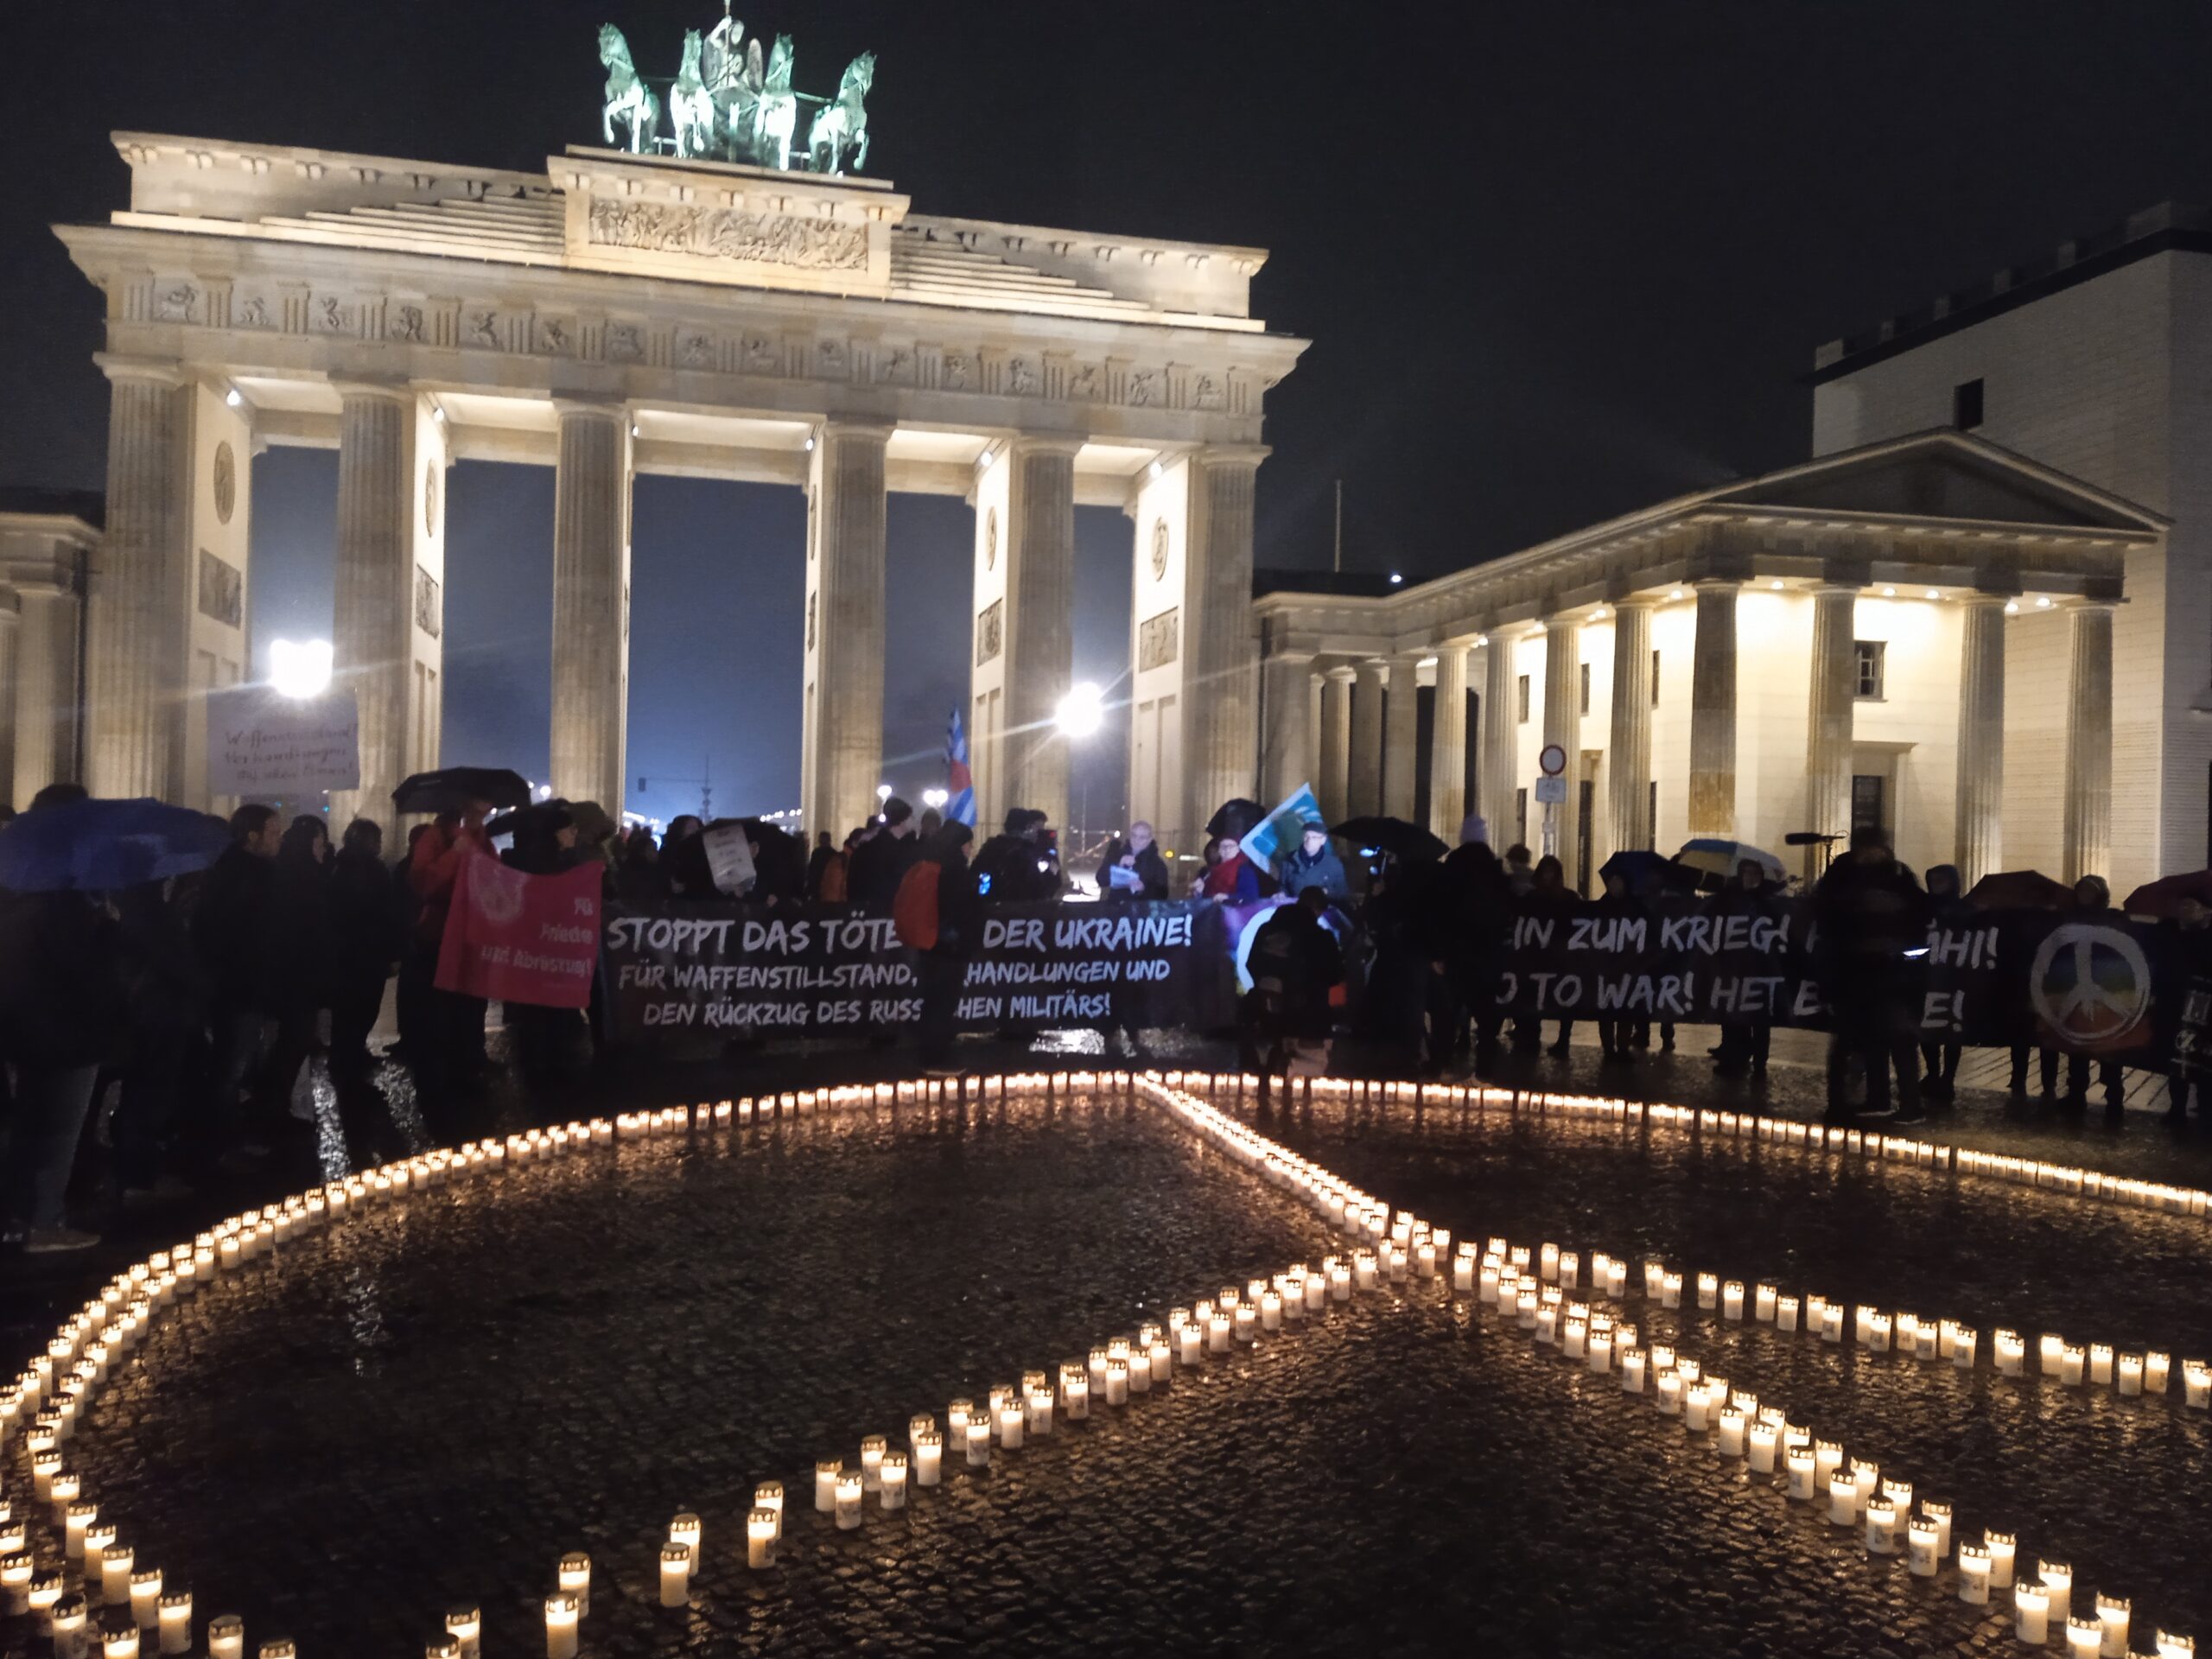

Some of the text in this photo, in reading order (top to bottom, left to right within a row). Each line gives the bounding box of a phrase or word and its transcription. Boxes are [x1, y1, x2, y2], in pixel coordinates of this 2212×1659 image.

[607, 911, 905, 954] STOPPT DAS TÖTE
[982, 913, 1193, 953] DER UKRAINE!
[1567, 916, 1646, 954] ZUM
[1661, 914, 1790, 956] KRIEG!
[619, 958, 918, 990] FÜR WAFFENSTILLSTAND,
[963, 958, 1171, 986] HANDLUNGEN UND
[1008, 988, 1112, 1020] MILITÄRS!
[1529, 972, 1583, 1011] TO
[1597, 970, 1695, 1016] WAR!
[643, 1001, 694, 1027] DEN
[702, 997, 810, 1027] RÜCKZUG
[816, 999, 862, 1025] DES
